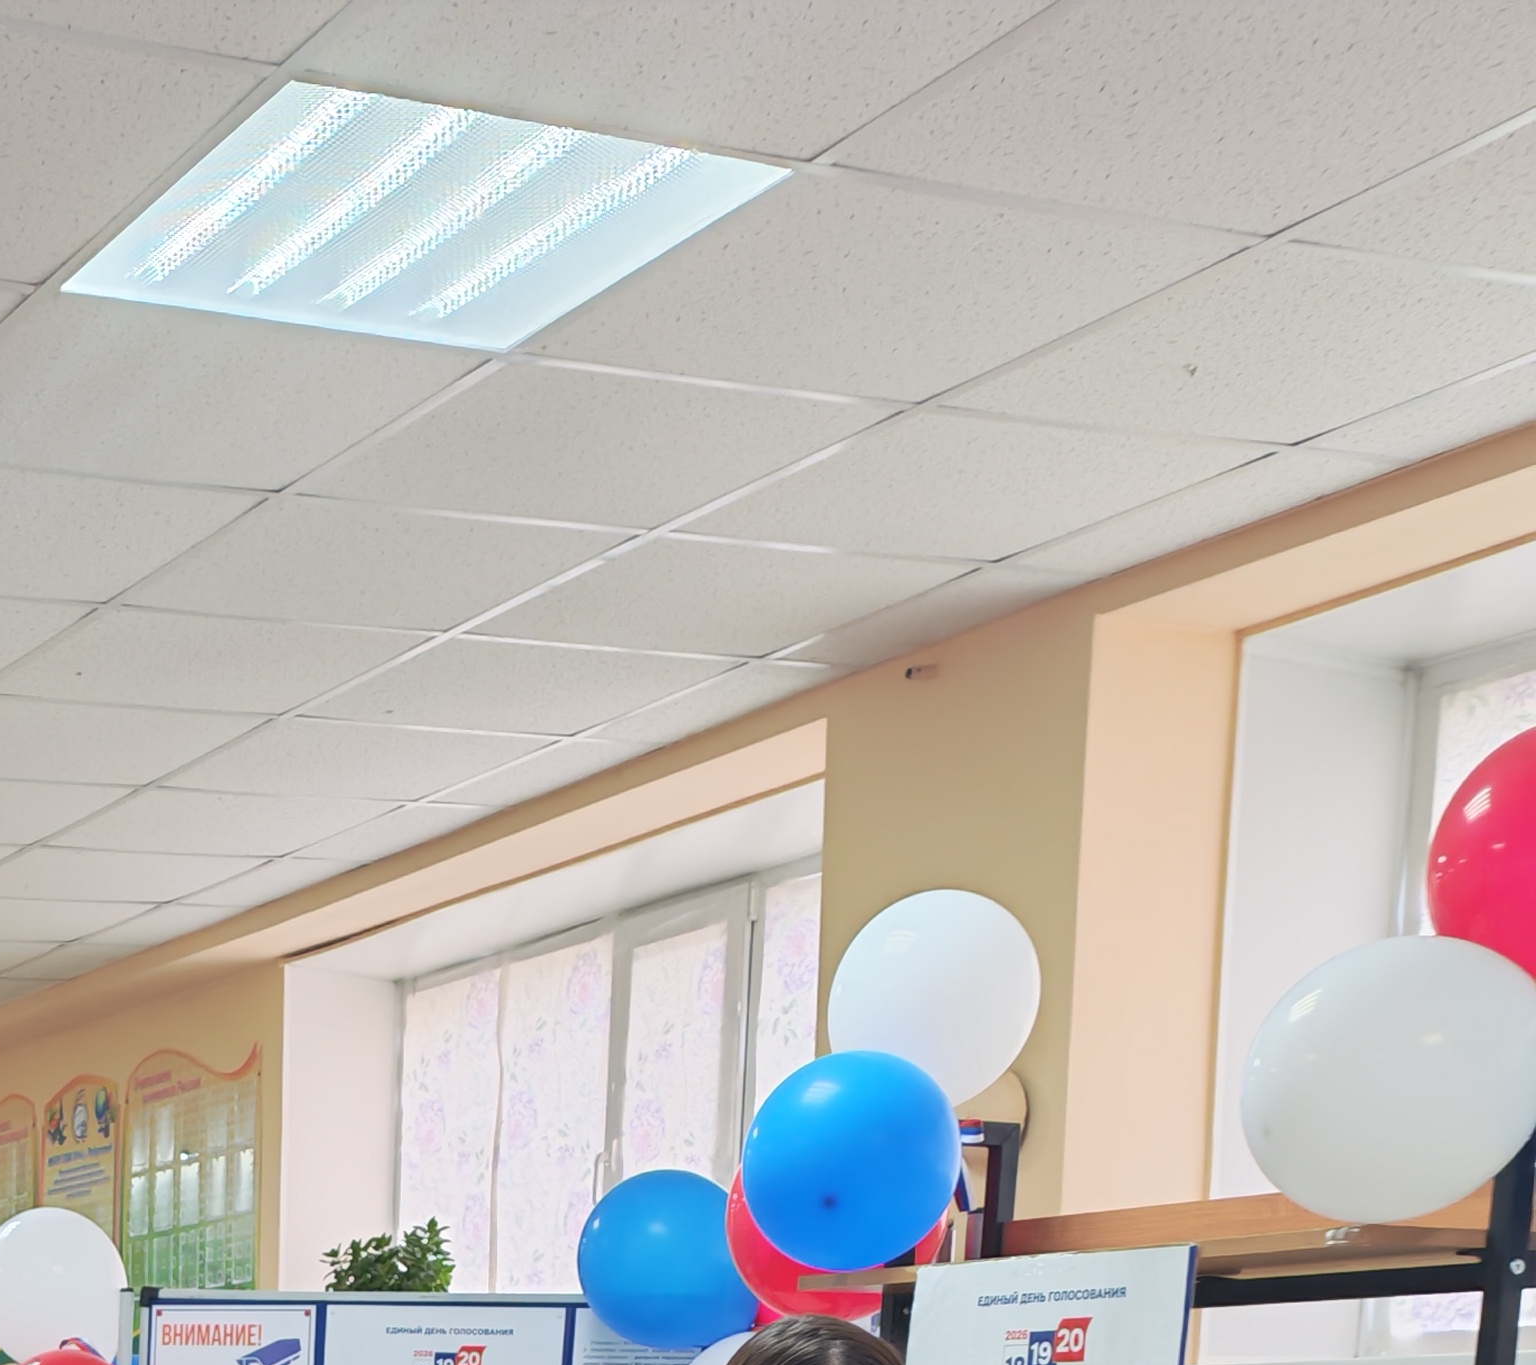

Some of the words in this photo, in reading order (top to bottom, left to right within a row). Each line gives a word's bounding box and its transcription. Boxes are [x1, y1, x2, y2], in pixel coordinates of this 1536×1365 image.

[977, 1291, 1019, 1307] ЕДИНЫЙ
[1019, 1290, 1046, 1305] ДЕНЬ
[1048, 1287, 1127, 1302] ГОЛОСОВАНИЯ
[161, 1323, 263, 1346] ВНИМАНИЕ!
[386, 1326, 423, 1335] ЕДИНЫЙ
[424, 1327, 447, 1336] ДЕНЬ
[449, 1327, 514, 1336] ГОЛОСОВАНИЯ
[1030, 1341, 1052, 1365] 19
[1055, 1327, 1084, 1353] 20
